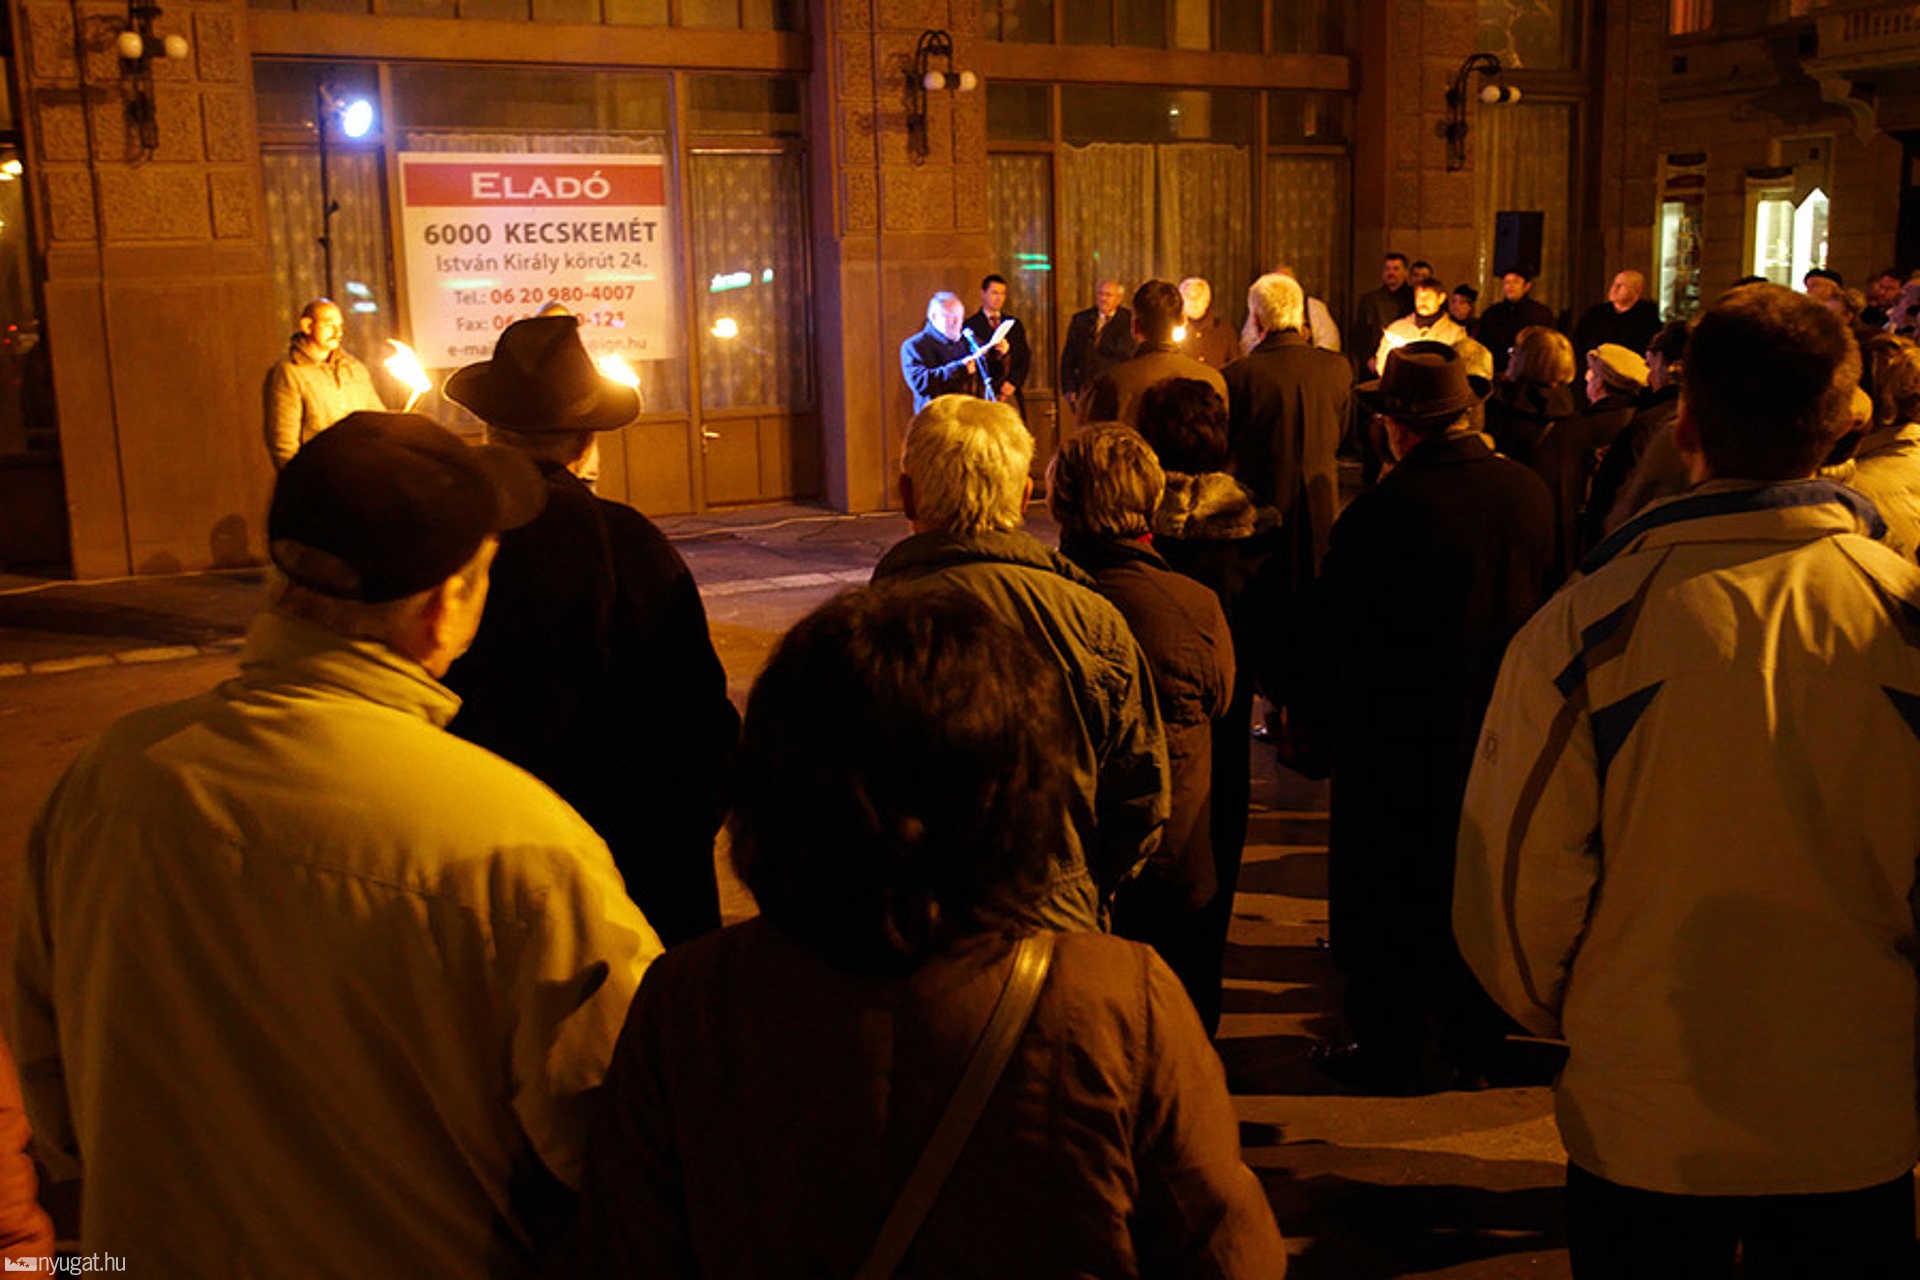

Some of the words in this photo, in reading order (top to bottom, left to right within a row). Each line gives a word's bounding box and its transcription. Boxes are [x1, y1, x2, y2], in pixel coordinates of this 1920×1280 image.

[423, 223, 493, 245] 6000
[504, 218, 658, 244] KECSKEMÉT
[436, 255, 499, 274] István
[503, 252, 560, 275] Király
[564, 250, 616, 270] körút
[620, 251, 649, 270] 24.
[454, 290, 487, 305] Tel.:
[490, 289, 515, 305] 06
[519, 287, 544, 304] 20
[548, 285, 636, 303] 980-4007
[457, 317, 488, 332] Fax:
